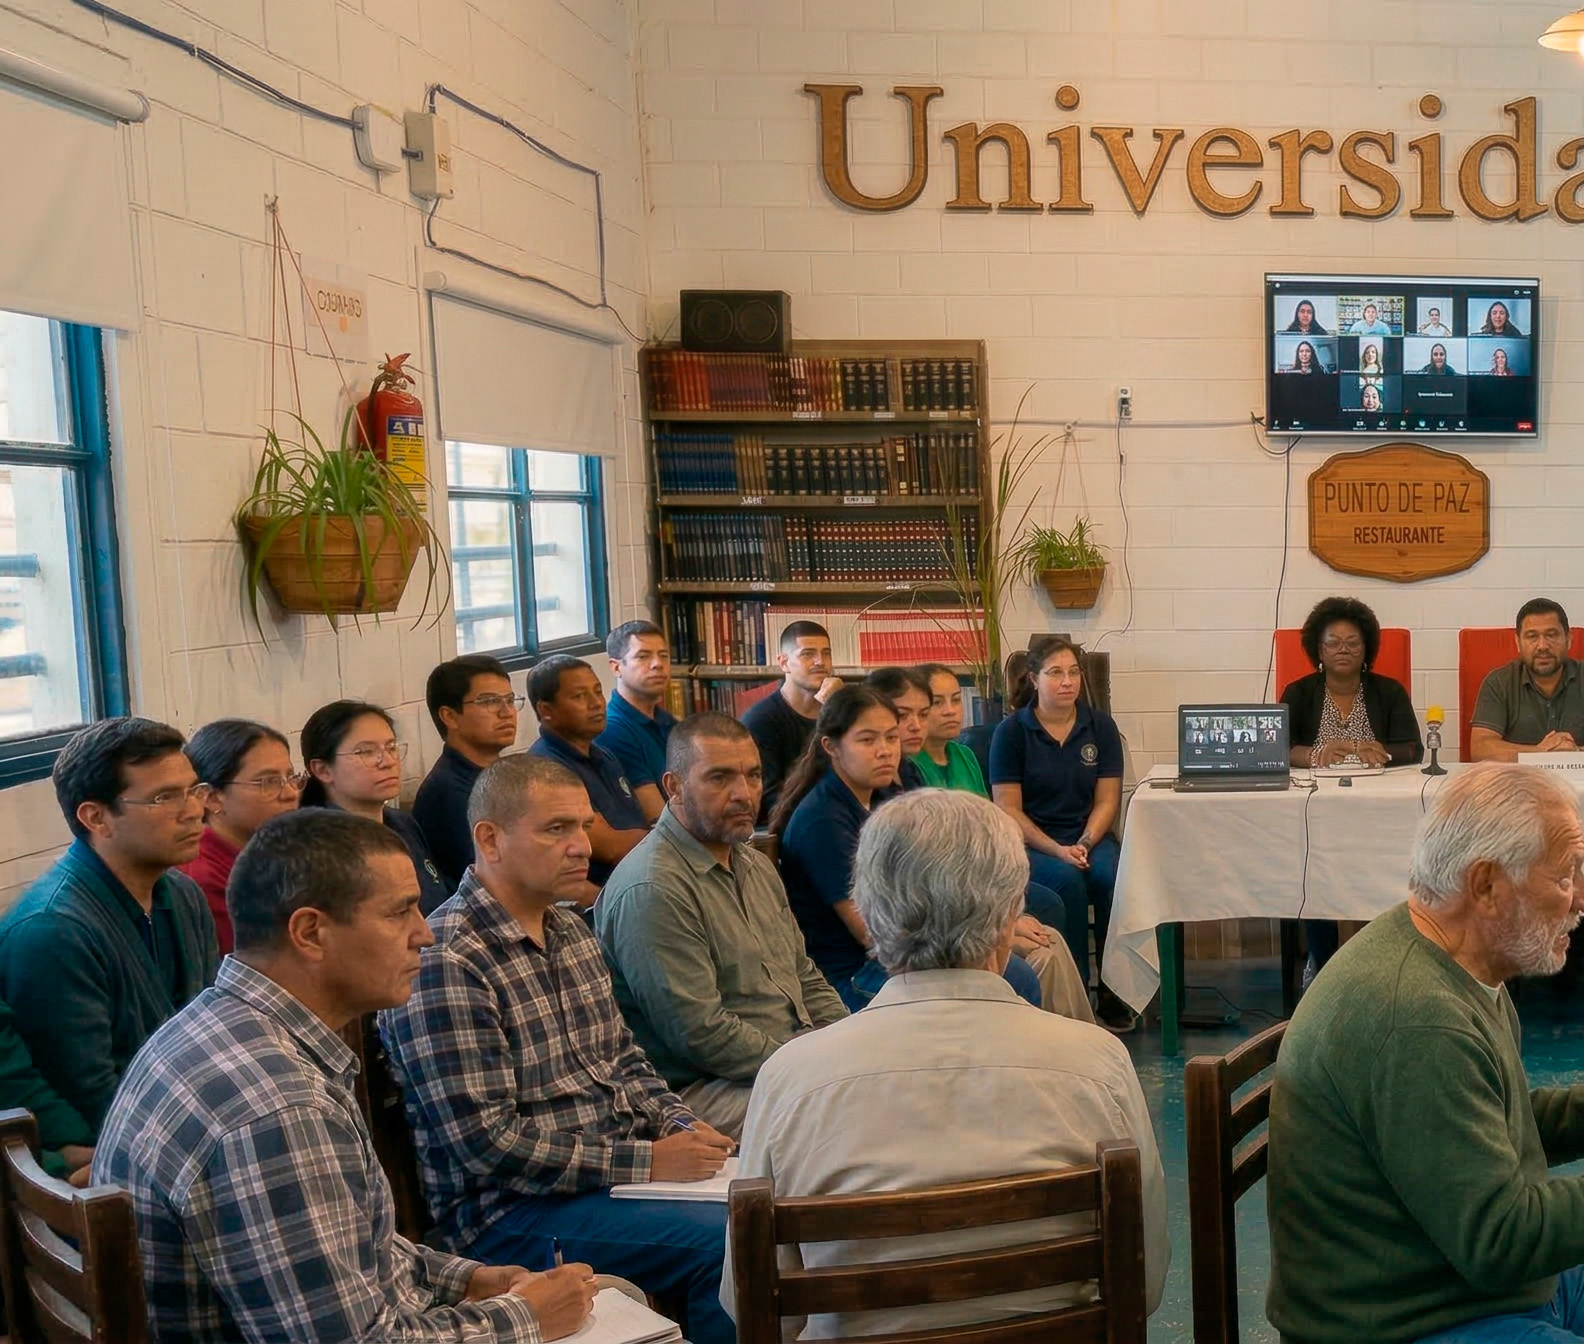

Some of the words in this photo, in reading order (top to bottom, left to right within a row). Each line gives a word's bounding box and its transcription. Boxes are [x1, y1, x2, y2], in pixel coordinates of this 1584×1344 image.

[1325, 482, 1390, 513] PUNTO
[1399, 482, 1423, 513] DE
[1433, 482, 1470, 513] PAZ
[1354, 526, 1445, 544] RESTAURANTE
